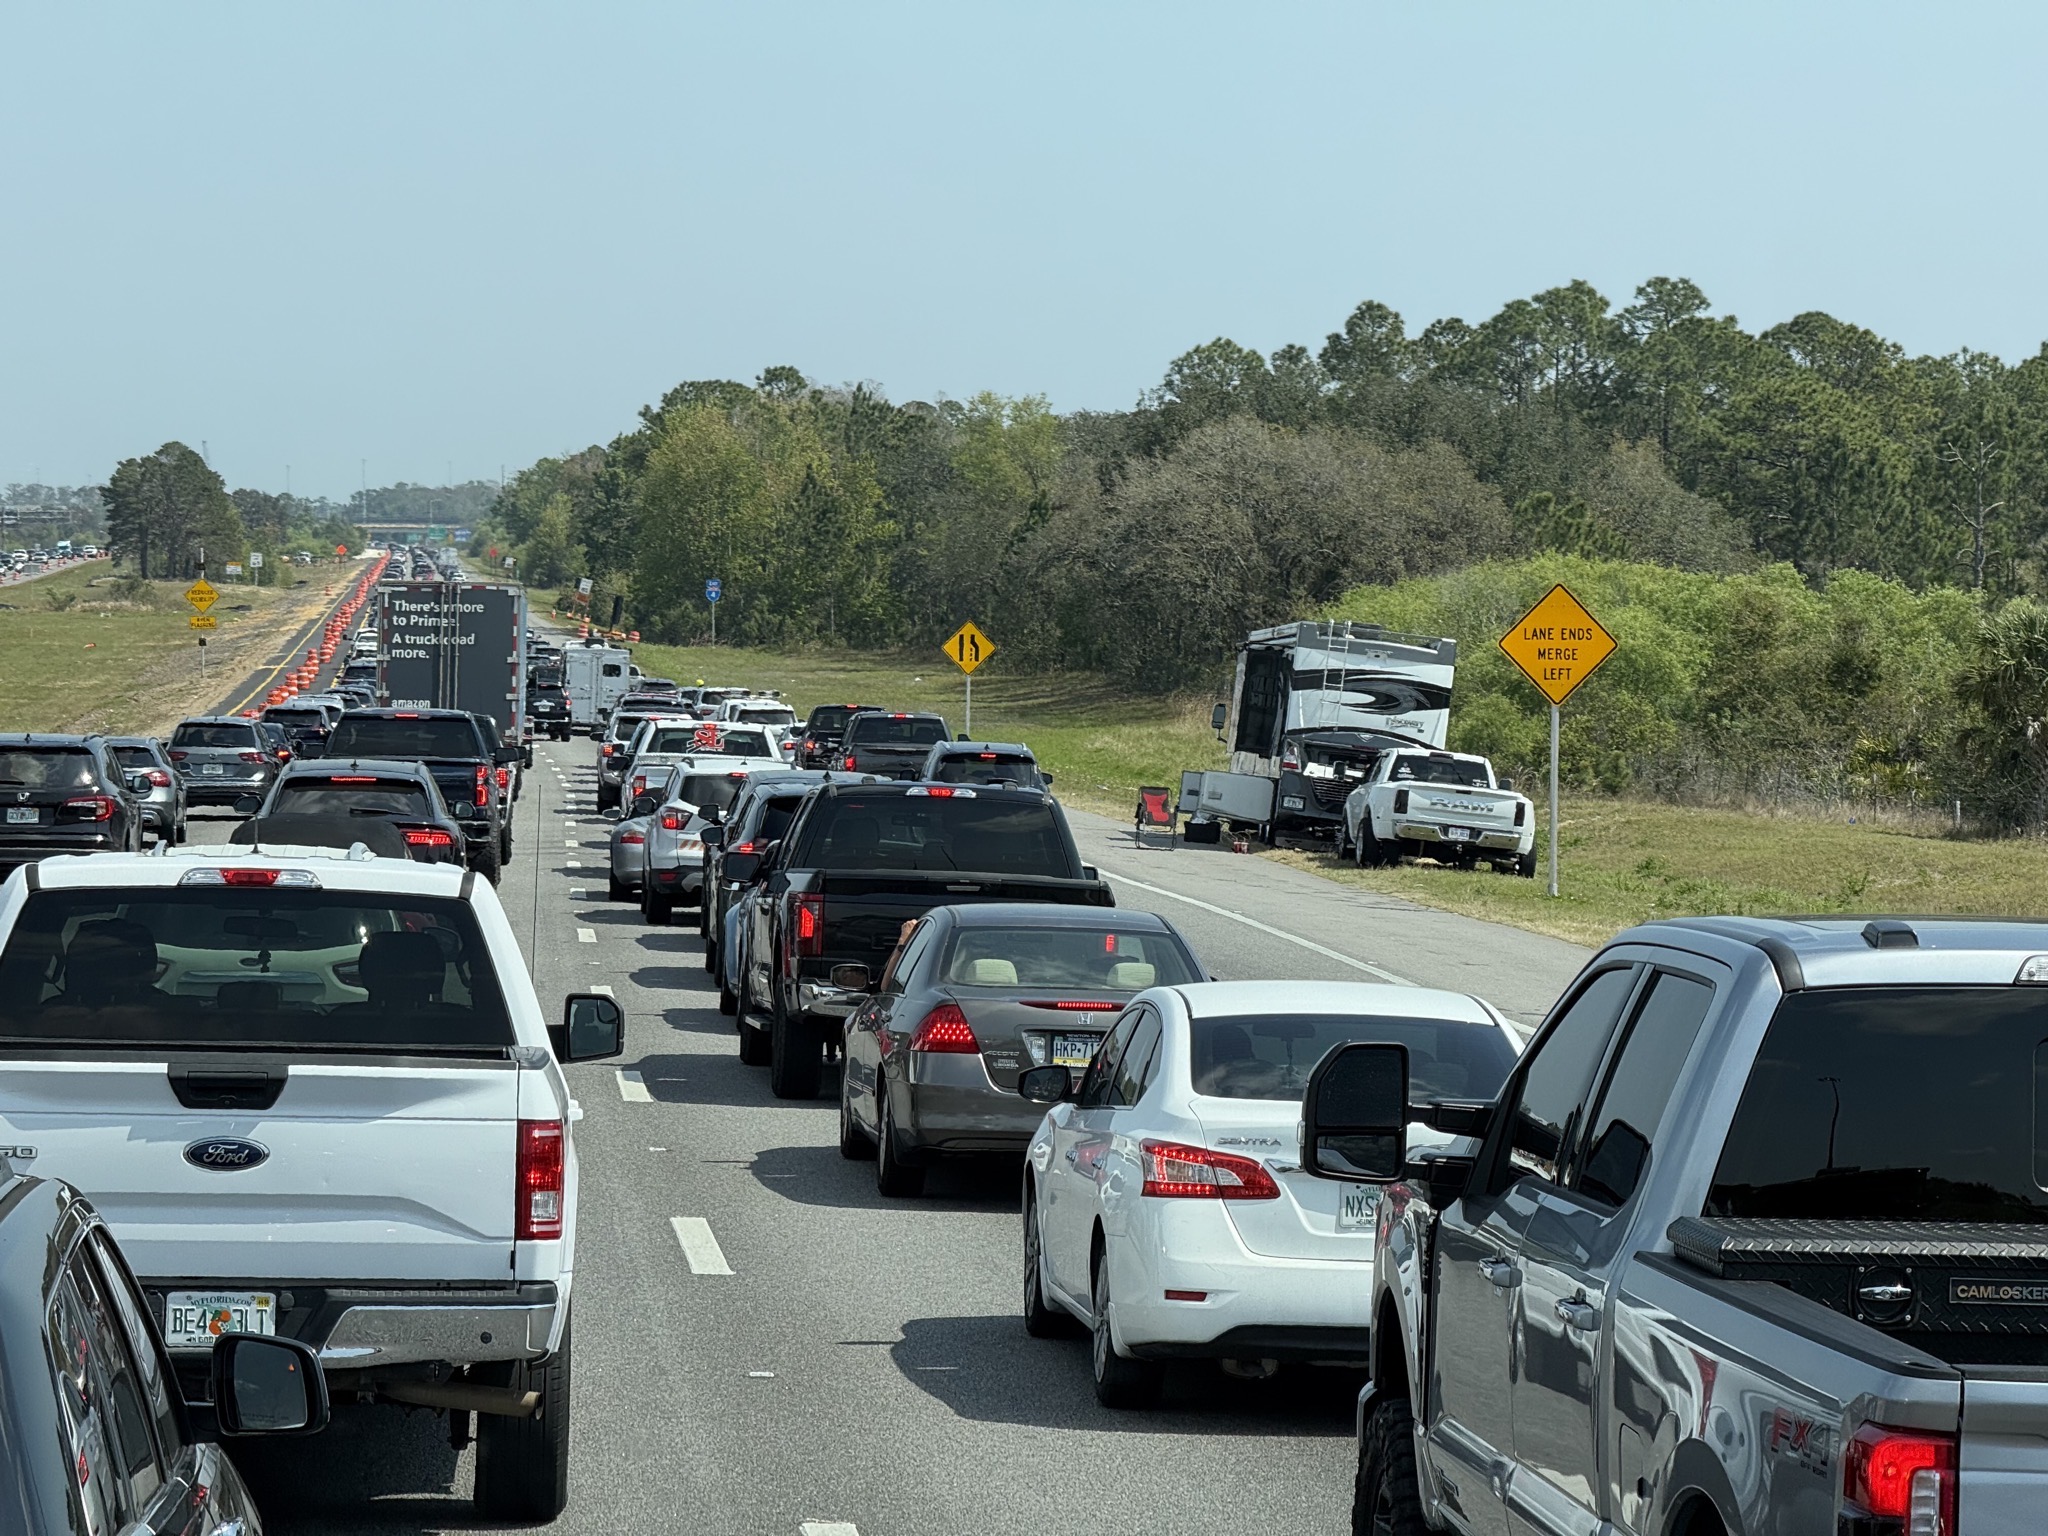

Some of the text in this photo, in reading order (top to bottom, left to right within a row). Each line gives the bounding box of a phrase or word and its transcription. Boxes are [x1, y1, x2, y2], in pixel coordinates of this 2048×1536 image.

[392, 600, 440, 612] There's
[392, 615, 407, 626] to
[391, 633, 402, 644] A
[1523, 628, 1593, 641] LANE ENDS
[391, 648, 430, 659] more.
[1537, 648, 1579, 661] MERGE
[1543, 668, 1572, 680] LEFT
[391, 699, 431, 709] amazon
[1431, 797, 1494, 813] RAM
[1217, 1136, 1283, 1147] SENTRA
[203, 1143, 249, 1164] Ford
[1771, 1407, 1830, 1467] FX4
